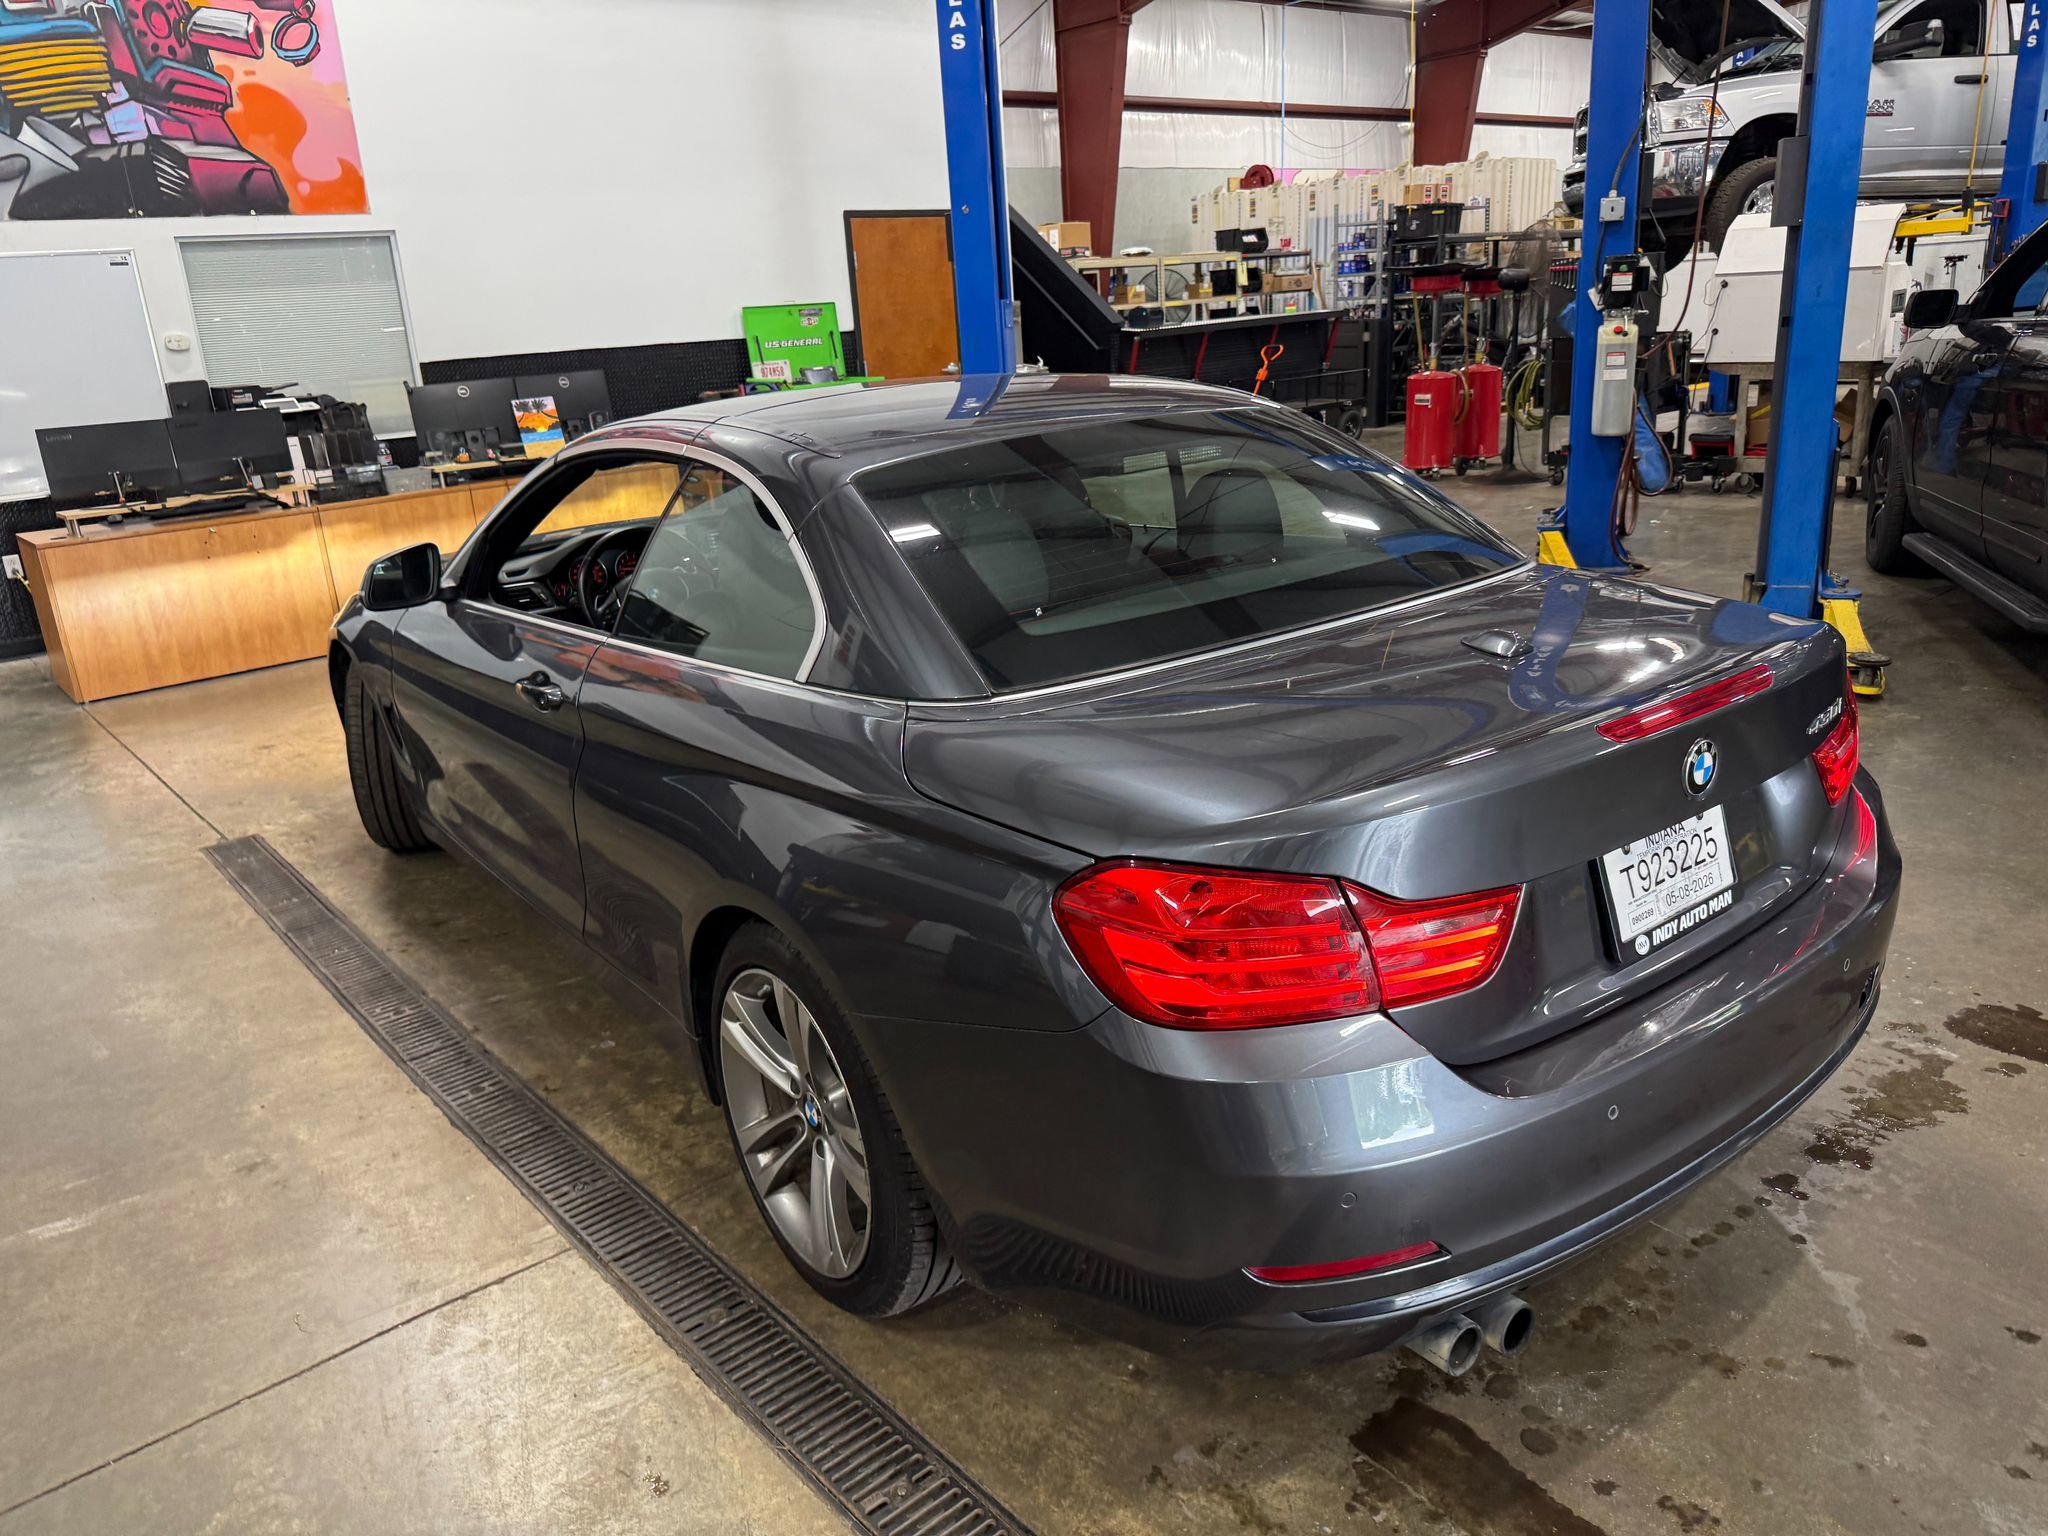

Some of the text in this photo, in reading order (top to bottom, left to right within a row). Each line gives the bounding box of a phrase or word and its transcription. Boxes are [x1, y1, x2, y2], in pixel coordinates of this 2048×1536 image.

[780, 338, 823, 347] GENERAL
[1645, 823, 1686, 849] INDIANA
[1619, 826, 1718, 899] T923225
[1665, 872, 1714, 907] 05-08-2026
[1652, 889, 1733, 946] INDY AUTO MAN
